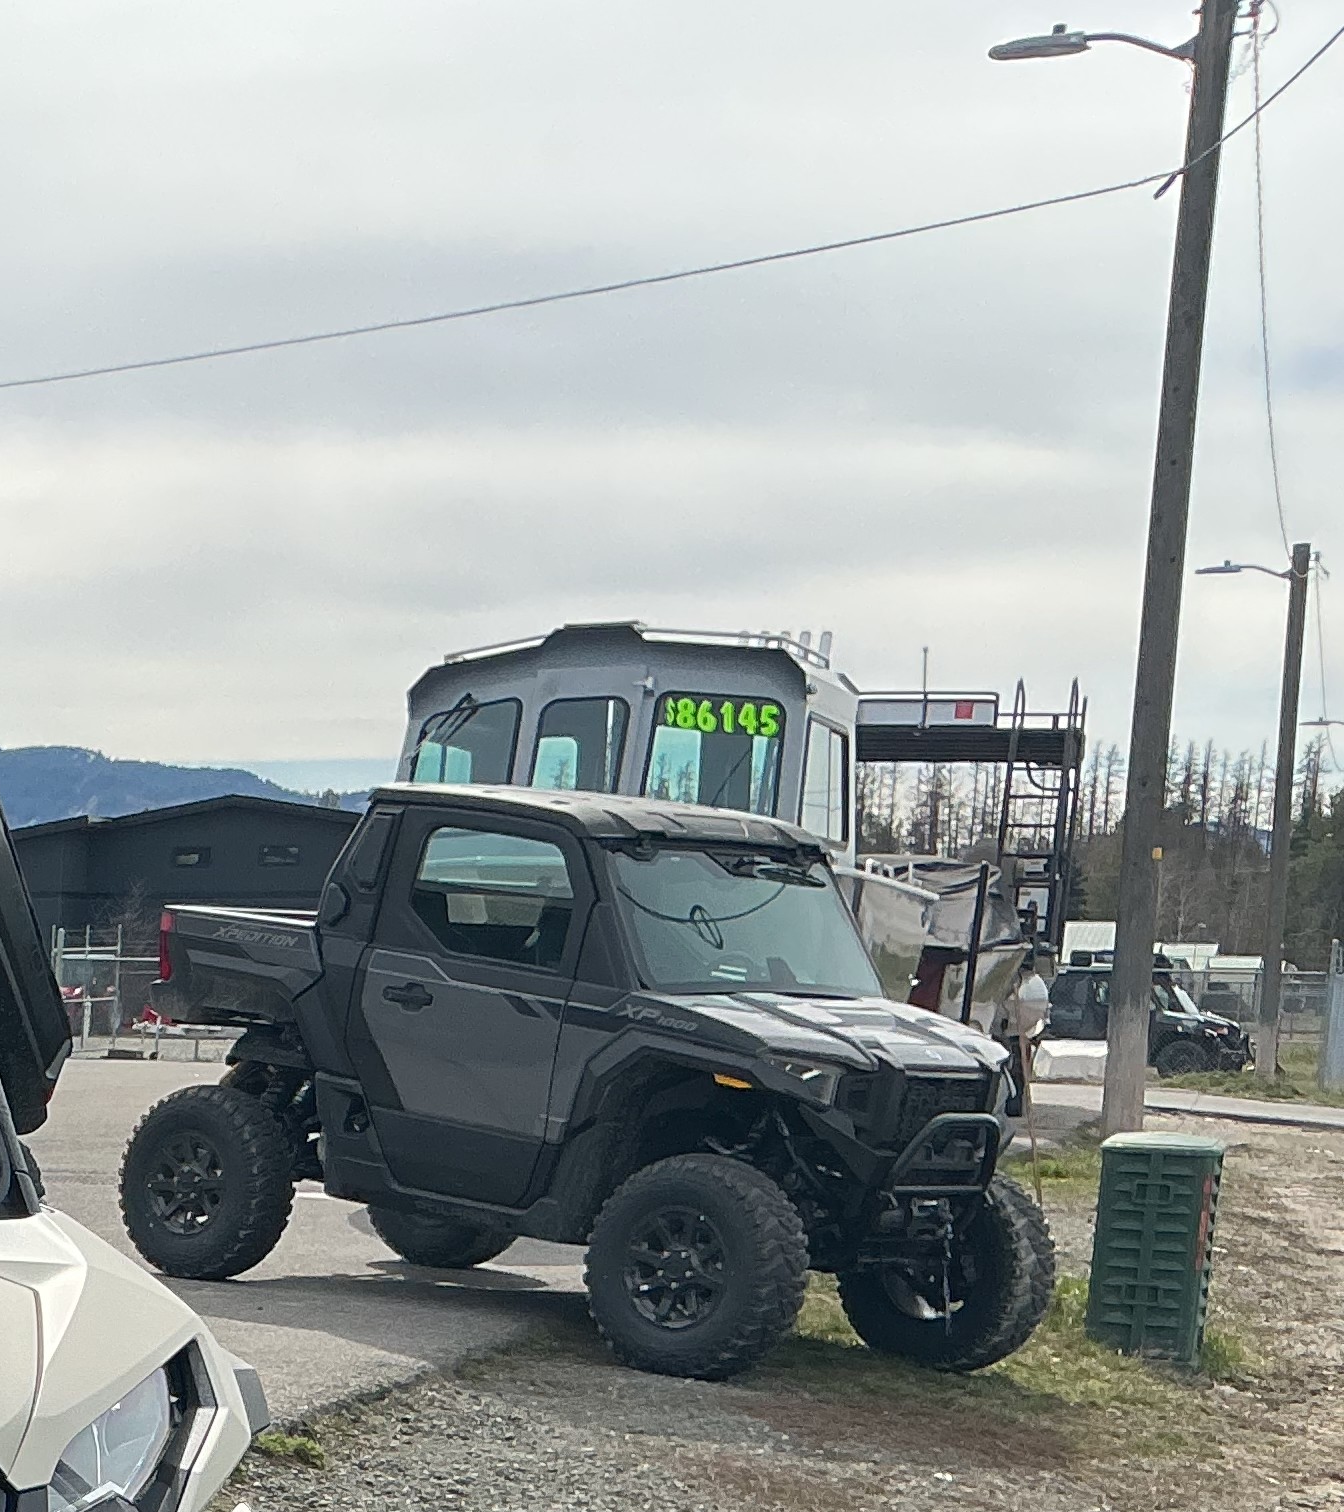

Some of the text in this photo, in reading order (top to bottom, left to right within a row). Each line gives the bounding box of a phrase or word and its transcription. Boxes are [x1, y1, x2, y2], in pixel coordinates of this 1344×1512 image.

[665, 697, 780, 736] $86145
[213, 924, 299, 947] XPEDITION
[615, 1004, 662, 1020] XP
